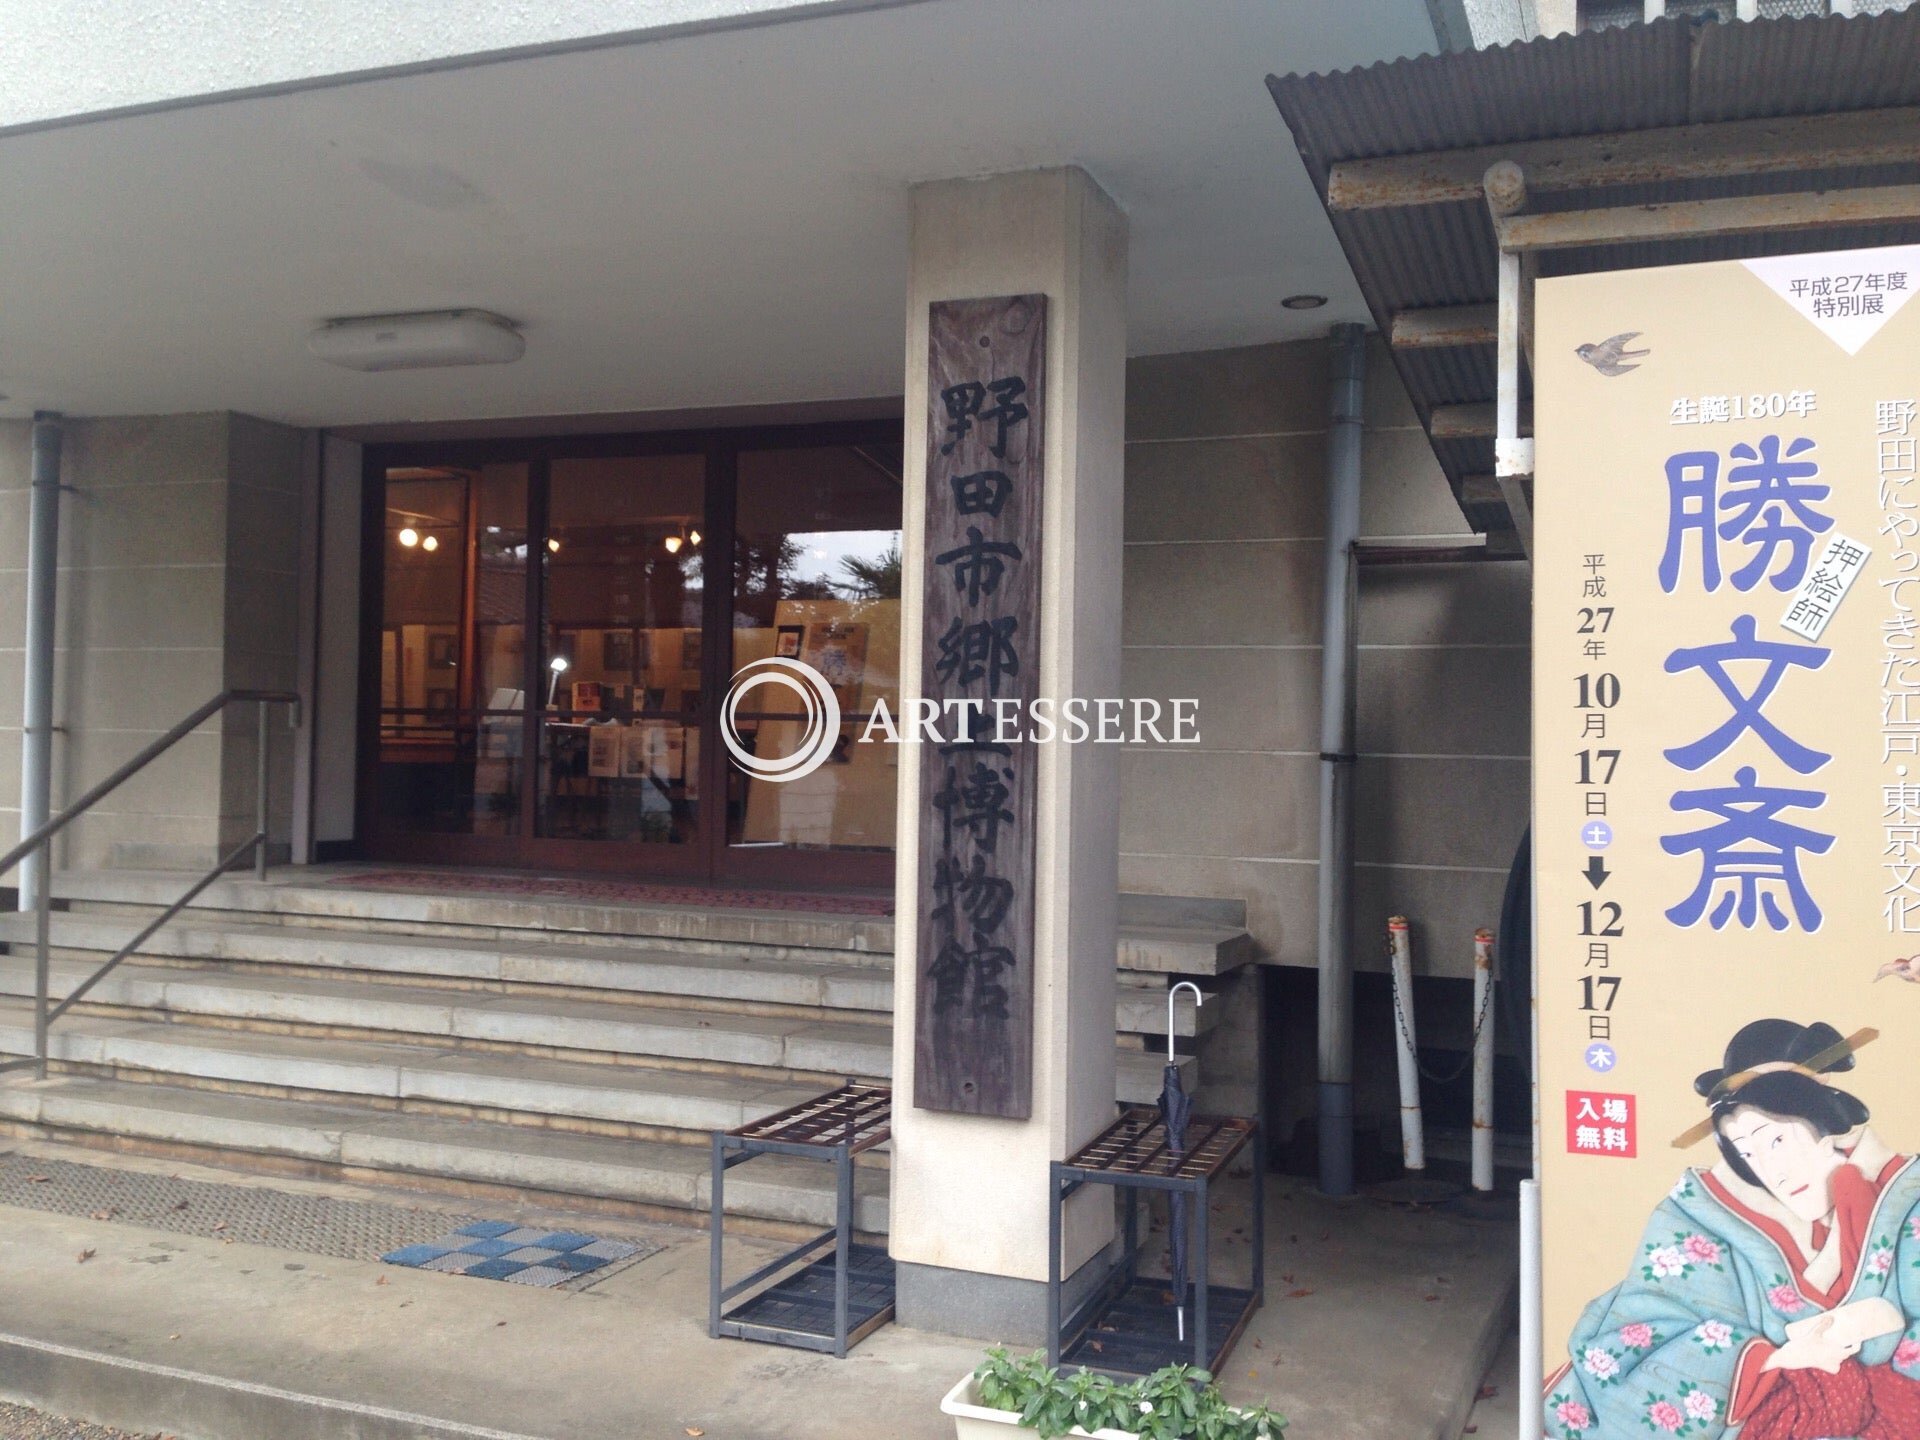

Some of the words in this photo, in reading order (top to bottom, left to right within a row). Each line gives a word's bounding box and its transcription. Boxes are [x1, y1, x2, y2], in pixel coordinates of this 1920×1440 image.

[1789, 271, 1909, 298] 平成27年度
[1812, 293, 1885, 319] 特別展
[1669, 389, 1818, 425] 生誕180年
[1785, 537, 1864, 633] 押絵師
